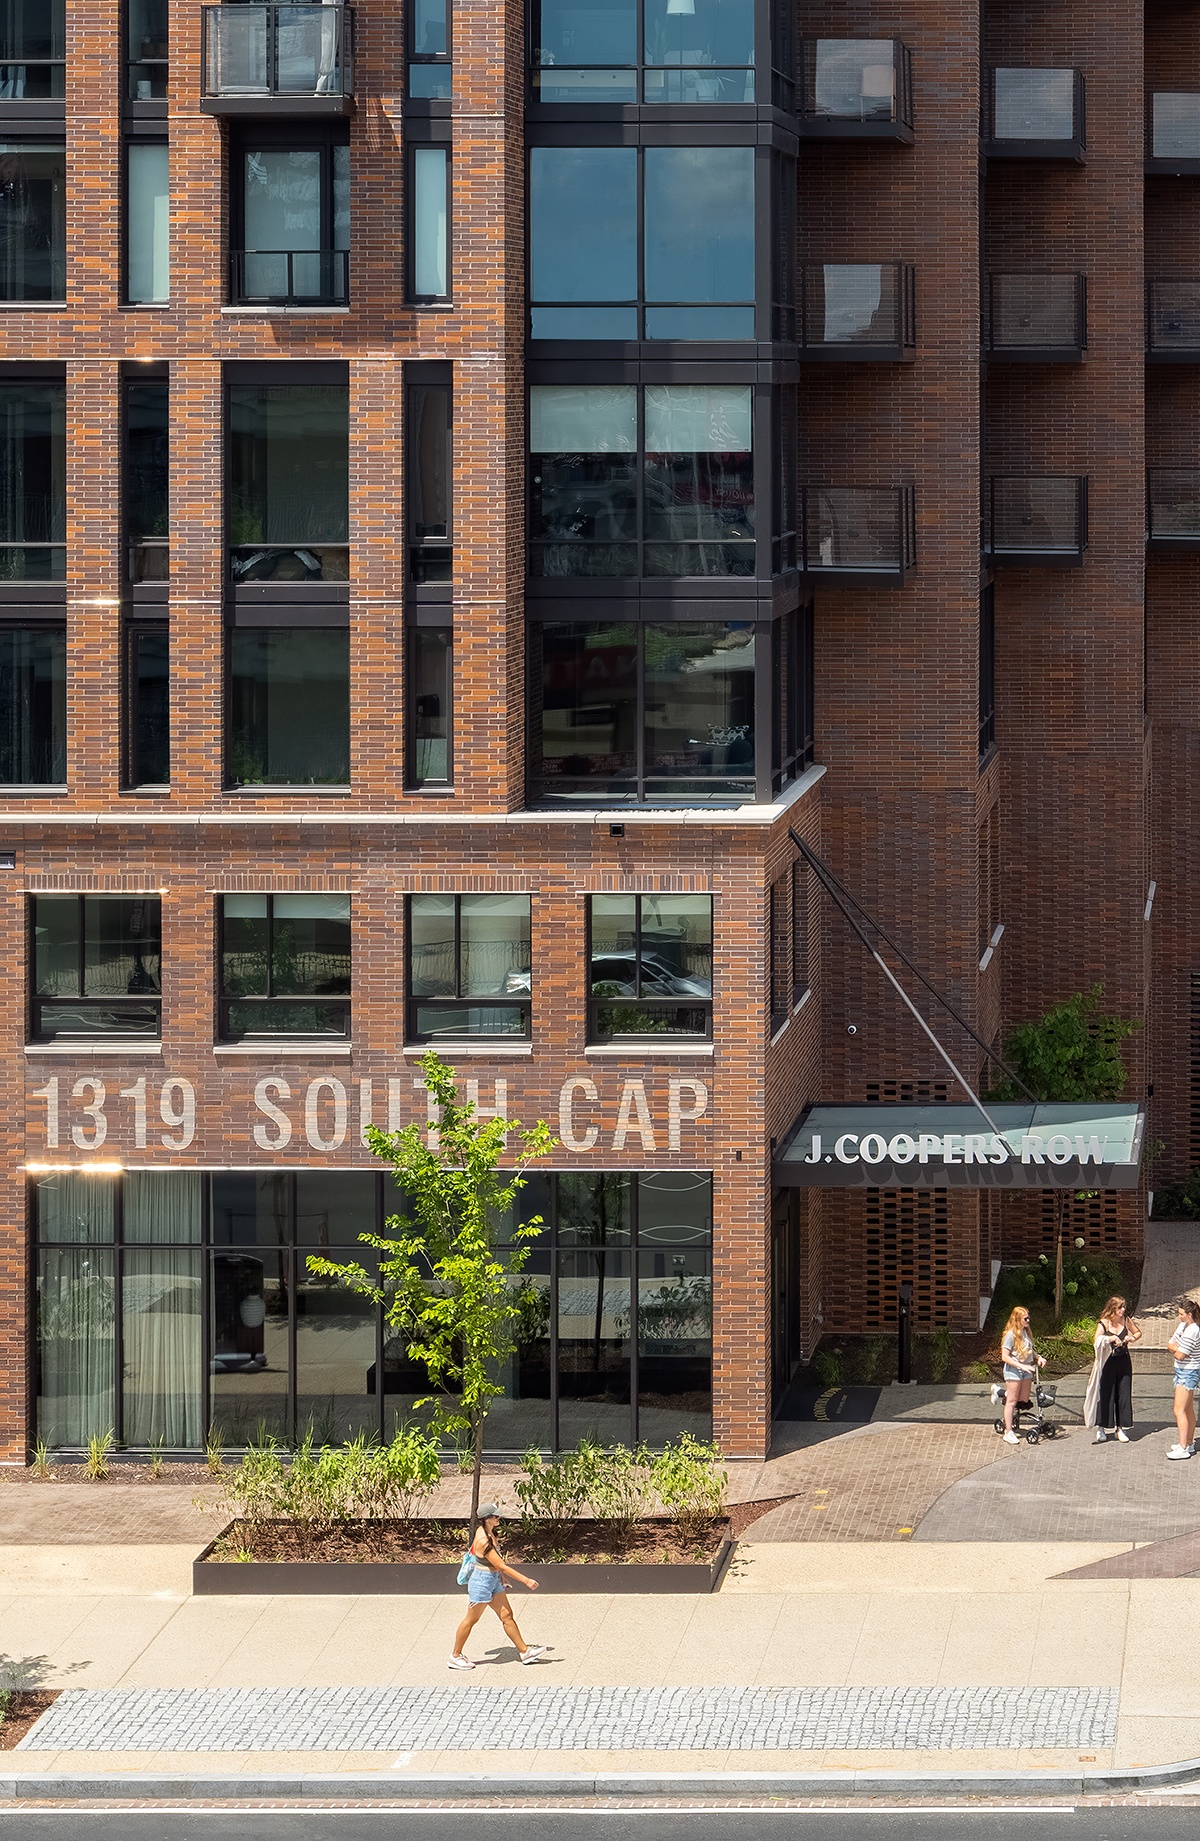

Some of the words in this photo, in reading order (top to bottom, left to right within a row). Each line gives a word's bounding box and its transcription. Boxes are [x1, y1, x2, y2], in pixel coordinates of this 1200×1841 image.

[33, 1077, 196, 1150] 1319
[253, 1076, 507, 1151] SOUTH
[558, 1076, 708, 1151] CAP
[804, 1133, 1010, 1165] J.COOPERS
[1021, 1134, 1109, 1165] ROW
